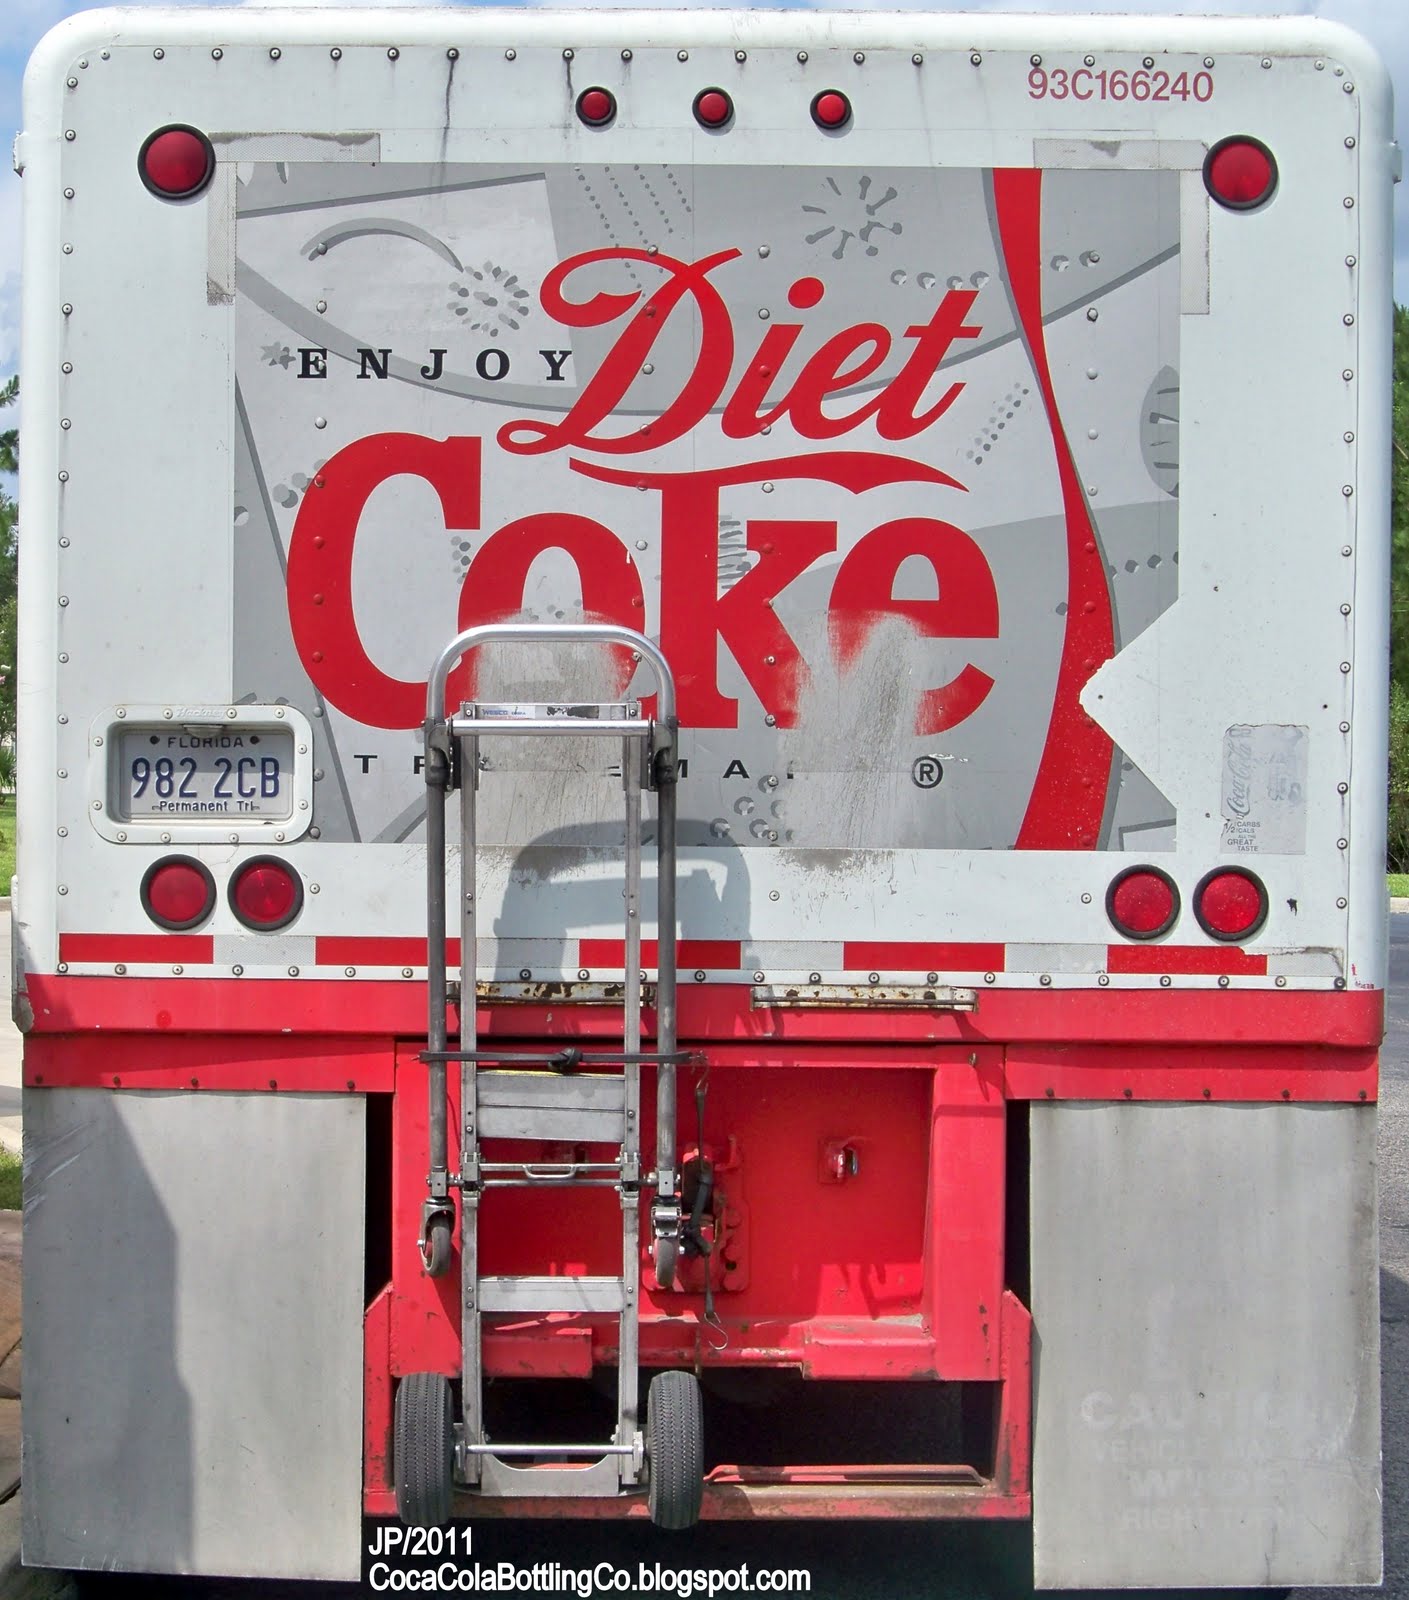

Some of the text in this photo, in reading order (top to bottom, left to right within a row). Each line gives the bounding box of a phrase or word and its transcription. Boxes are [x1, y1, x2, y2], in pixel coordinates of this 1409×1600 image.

[1028, 67, 1214, 102] 93C166240
[296, 347, 574, 382] ENJOY
[496, 247, 983, 455] Diet
[286, 432, 1000, 735] Coke
[167, 736, 244, 749] FLORIDA
[131, 757, 280, 799] 982 2CB
[159, 800, 228, 812] Permanent
[1226, 838, 1254, 846] GREAT
